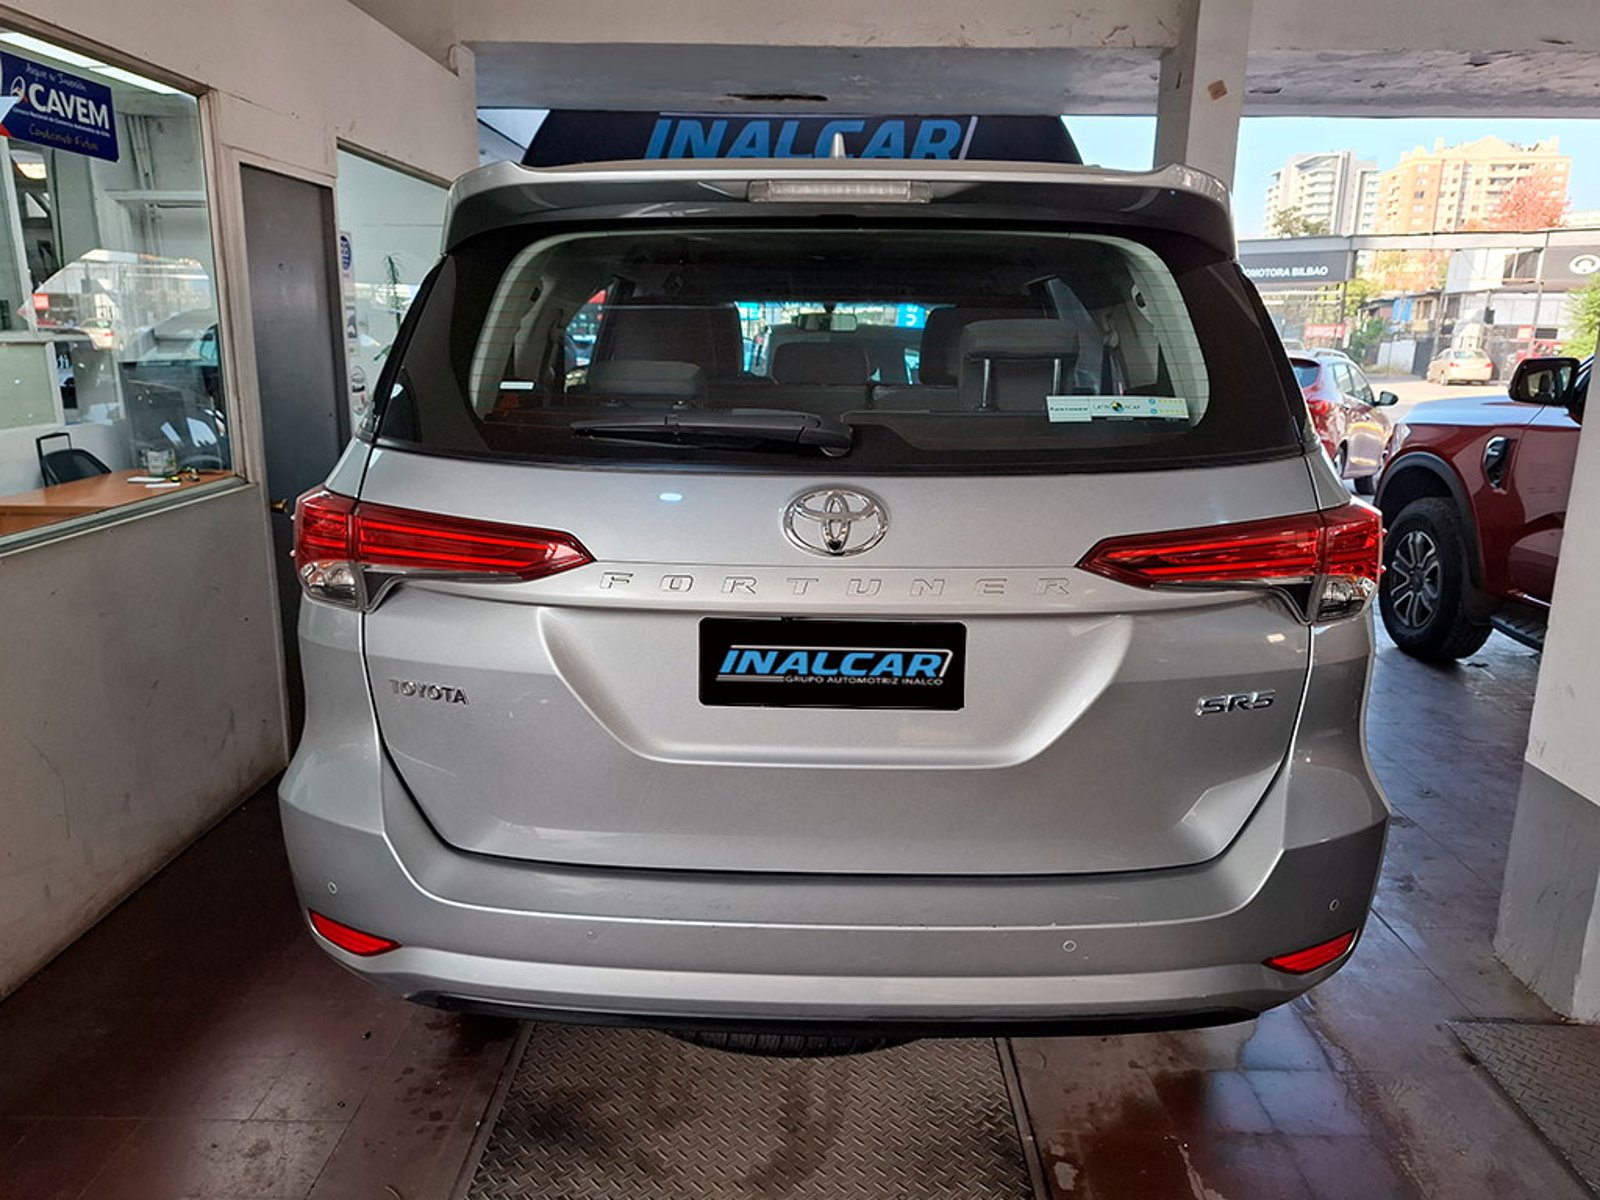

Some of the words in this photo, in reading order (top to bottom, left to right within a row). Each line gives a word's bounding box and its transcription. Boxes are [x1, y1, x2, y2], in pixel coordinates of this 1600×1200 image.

[28, 83, 110, 130] CAVEM
[644, 118, 962, 160] INALCAR
[1292, 265, 1328, 277] BILBAO
[599, 571, 1070, 597] FORTUNER
[719, 649, 943, 678] INALCAR
[389, 679, 469, 705] TOYOTA
[785, 675, 824, 684] GRUPO
[826, 676, 899, 686] AUTOMOTRIZ
[901, 677, 944, 686] INALCO
[1195, 689, 1276, 716] SR5
